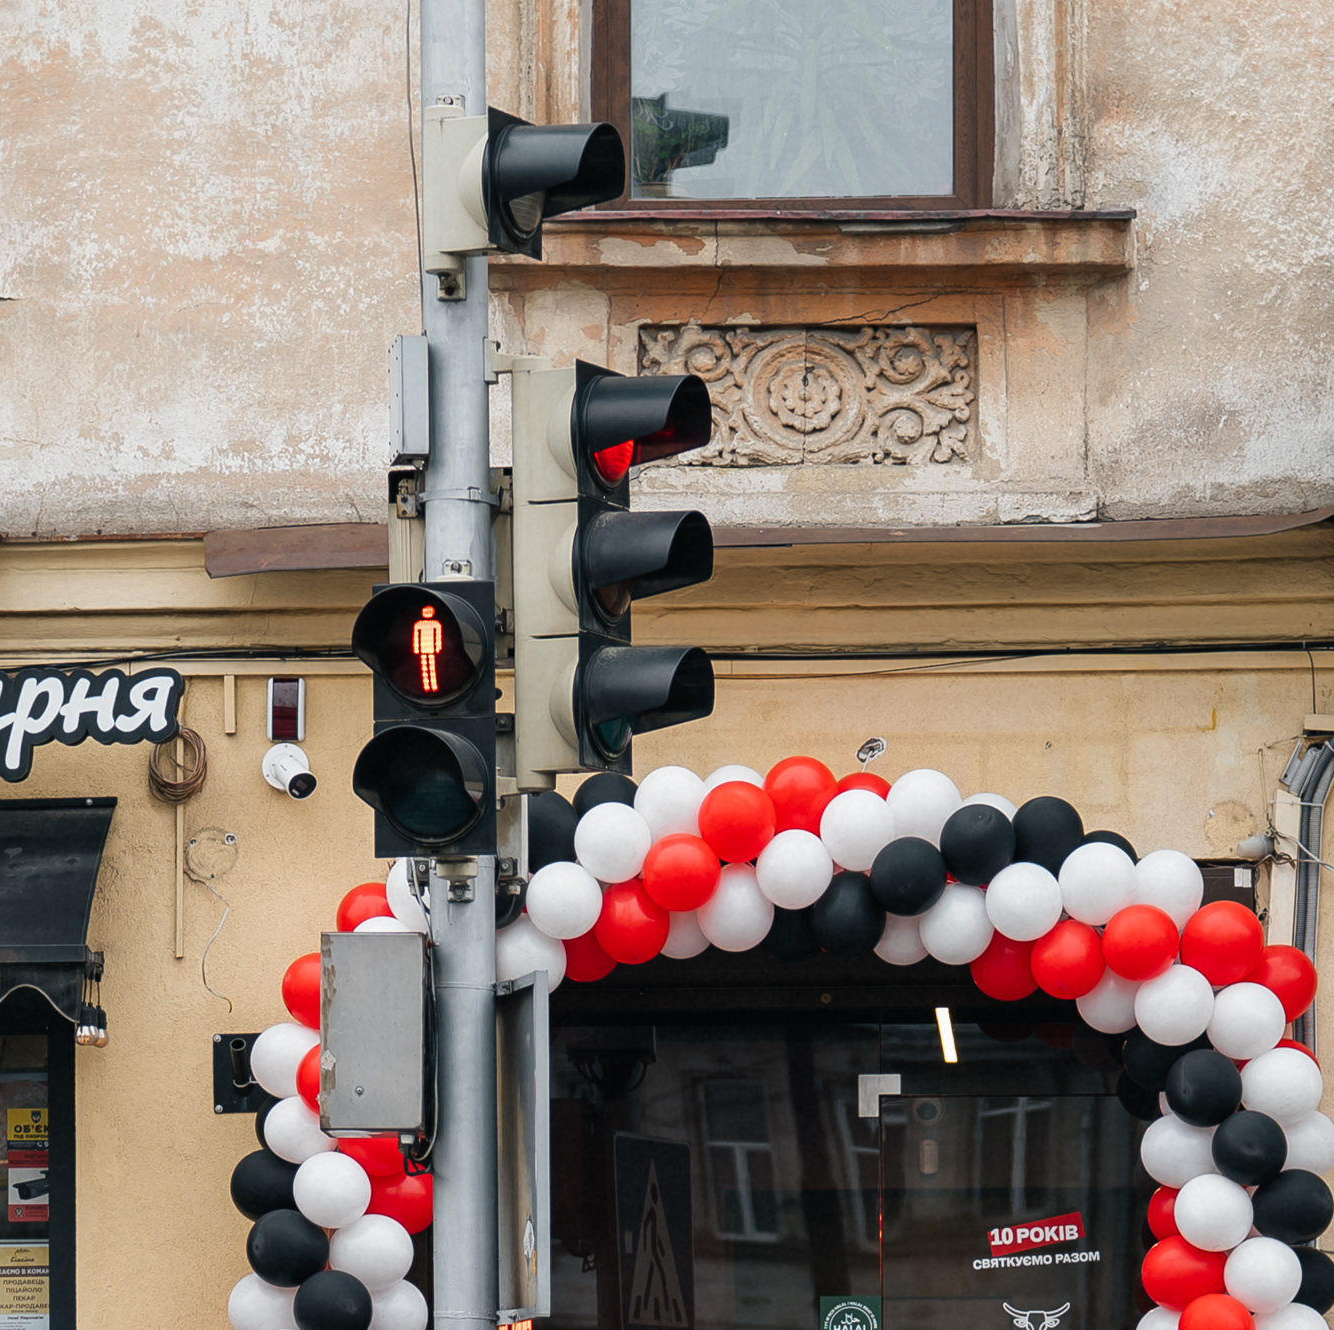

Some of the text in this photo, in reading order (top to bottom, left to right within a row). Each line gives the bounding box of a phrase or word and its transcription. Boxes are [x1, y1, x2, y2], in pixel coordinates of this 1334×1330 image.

[990, 1224, 1079, 1246] 10 РОКІВ
[972, 1251, 1100, 1270] СВЯТКУЄМО РАЗОМ
